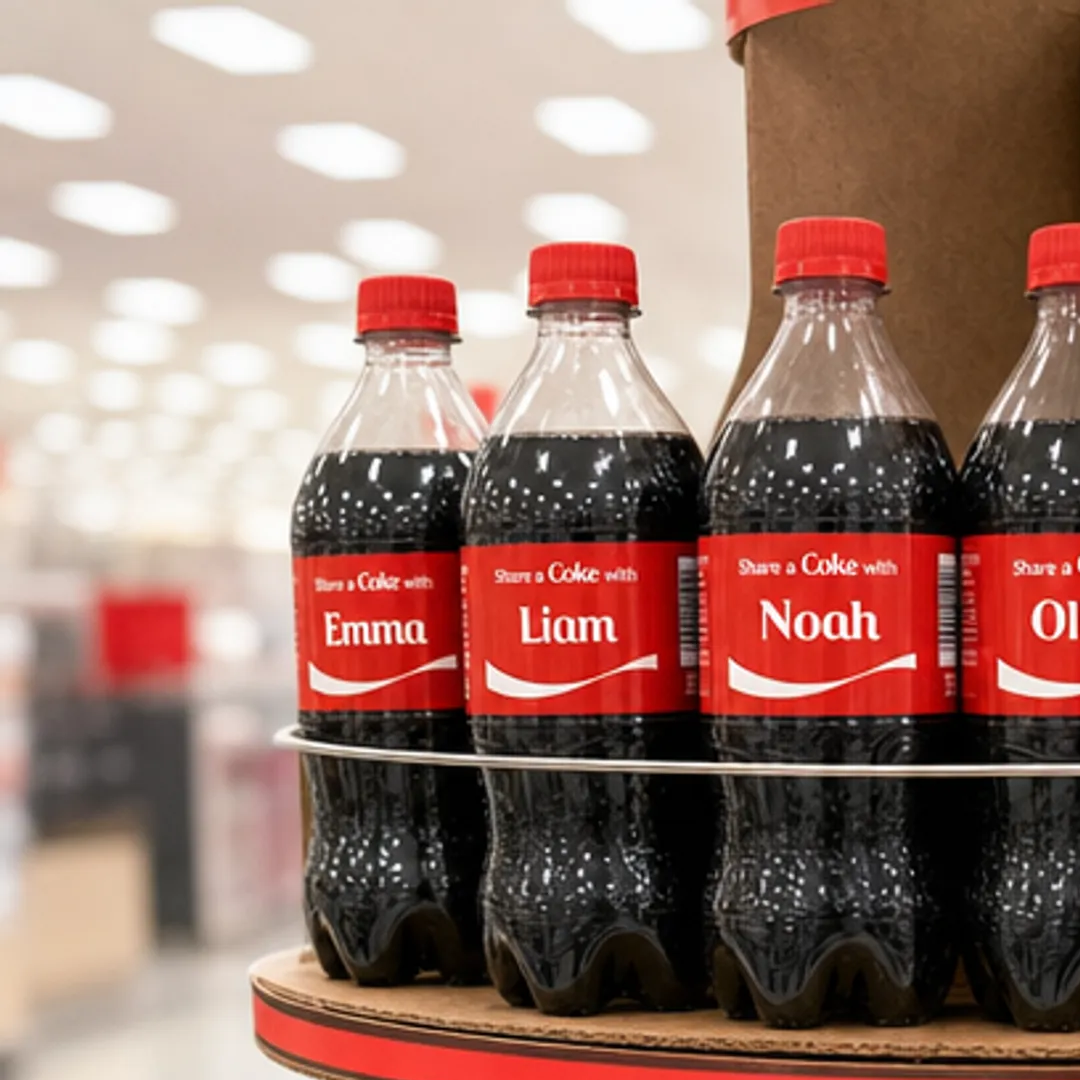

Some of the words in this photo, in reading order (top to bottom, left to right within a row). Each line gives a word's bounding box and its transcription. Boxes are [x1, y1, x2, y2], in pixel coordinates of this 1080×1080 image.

[494, 568, 531, 584] Share
[548, 561, 600, 584] Coke
[738, 558, 781, 576] Share
[801, 552, 859, 576] Coke
[1013, 559, 1057, 576] Share
[357, 571, 401, 592] Coke
[324, 611, 428, 647] Emma
[519, 605, 618, 644] Liam
[759, 599, 881, 641] Noah
